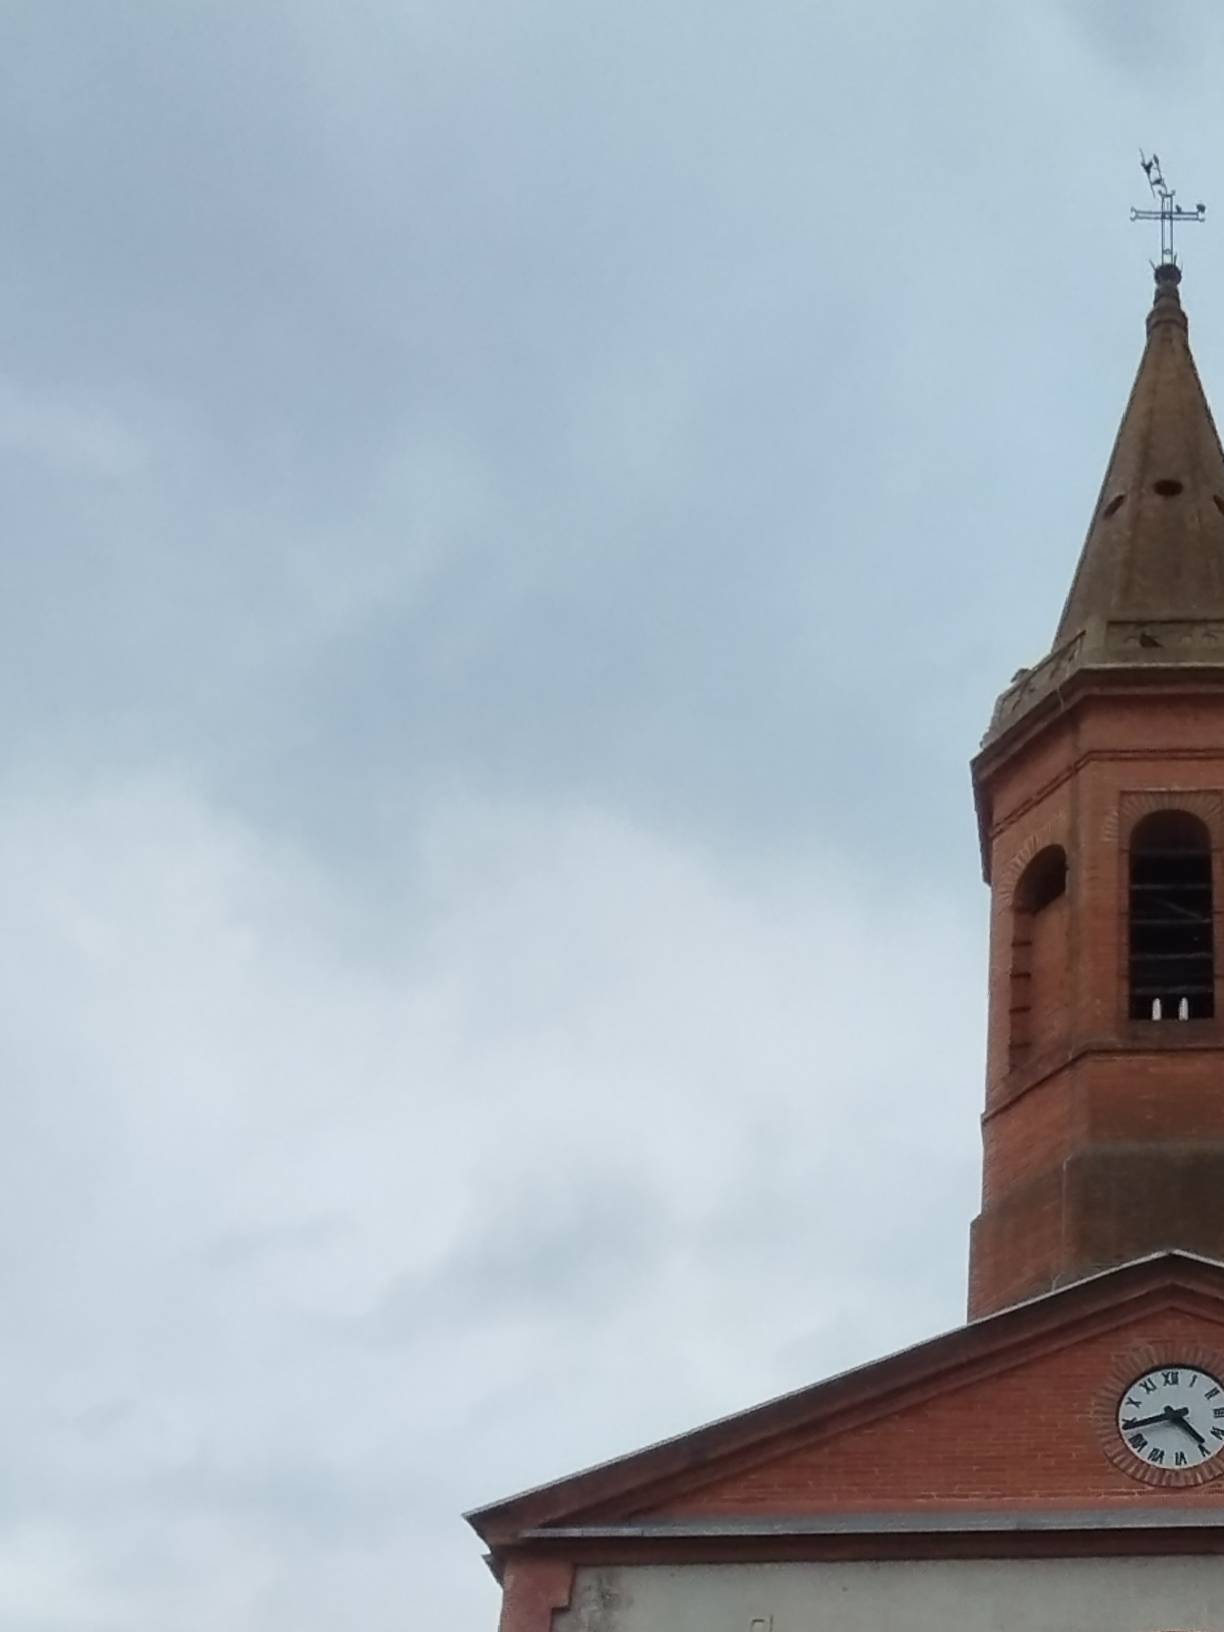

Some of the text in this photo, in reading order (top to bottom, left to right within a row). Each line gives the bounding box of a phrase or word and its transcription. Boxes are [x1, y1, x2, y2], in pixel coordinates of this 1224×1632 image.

[1139, 1378, 1156, 1395] XI
[1162, 1372, 1178, 1387] XII
[1203, 1387, 1220, 1400] II
[1125, 1397, 1141, 1409] X
